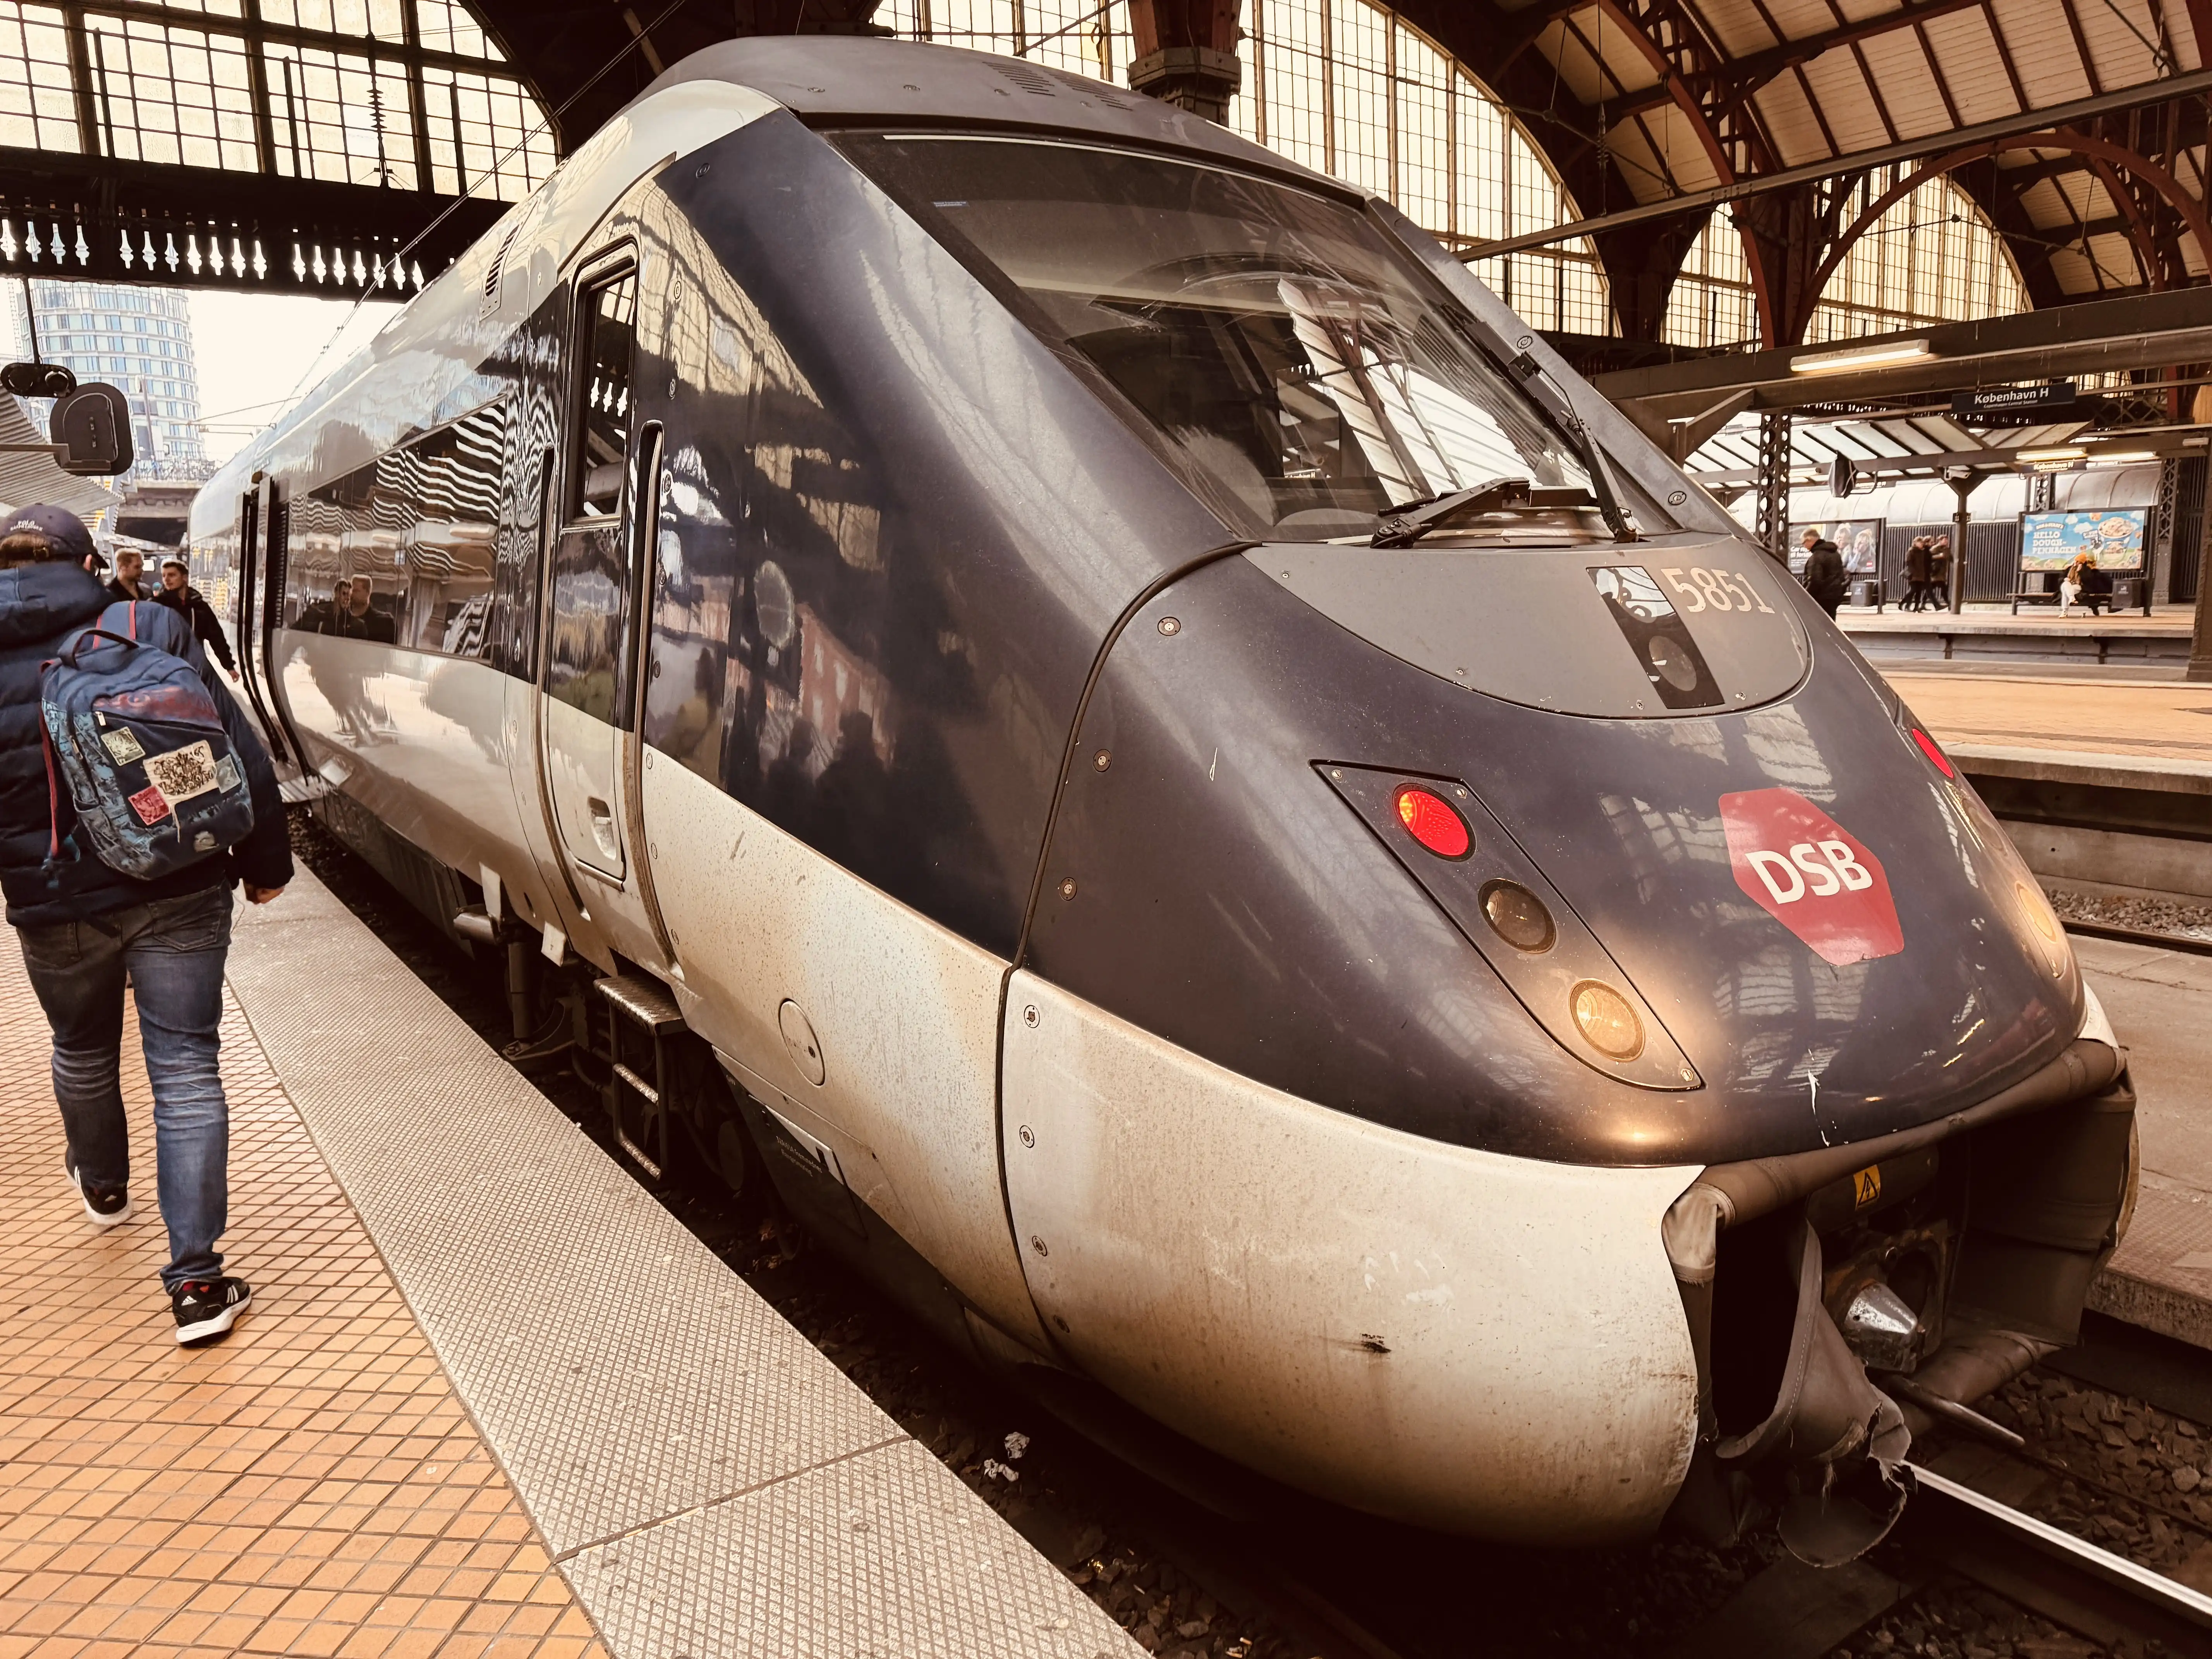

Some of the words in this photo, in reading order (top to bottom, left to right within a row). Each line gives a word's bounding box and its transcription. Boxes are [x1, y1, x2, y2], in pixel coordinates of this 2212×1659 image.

[1974, 390, 2036, 404] København
[2040, 387, 2049, 397] H
[1661, 567, 1775, 614] 5851
[1745, 840, 1873, 904] DSB
